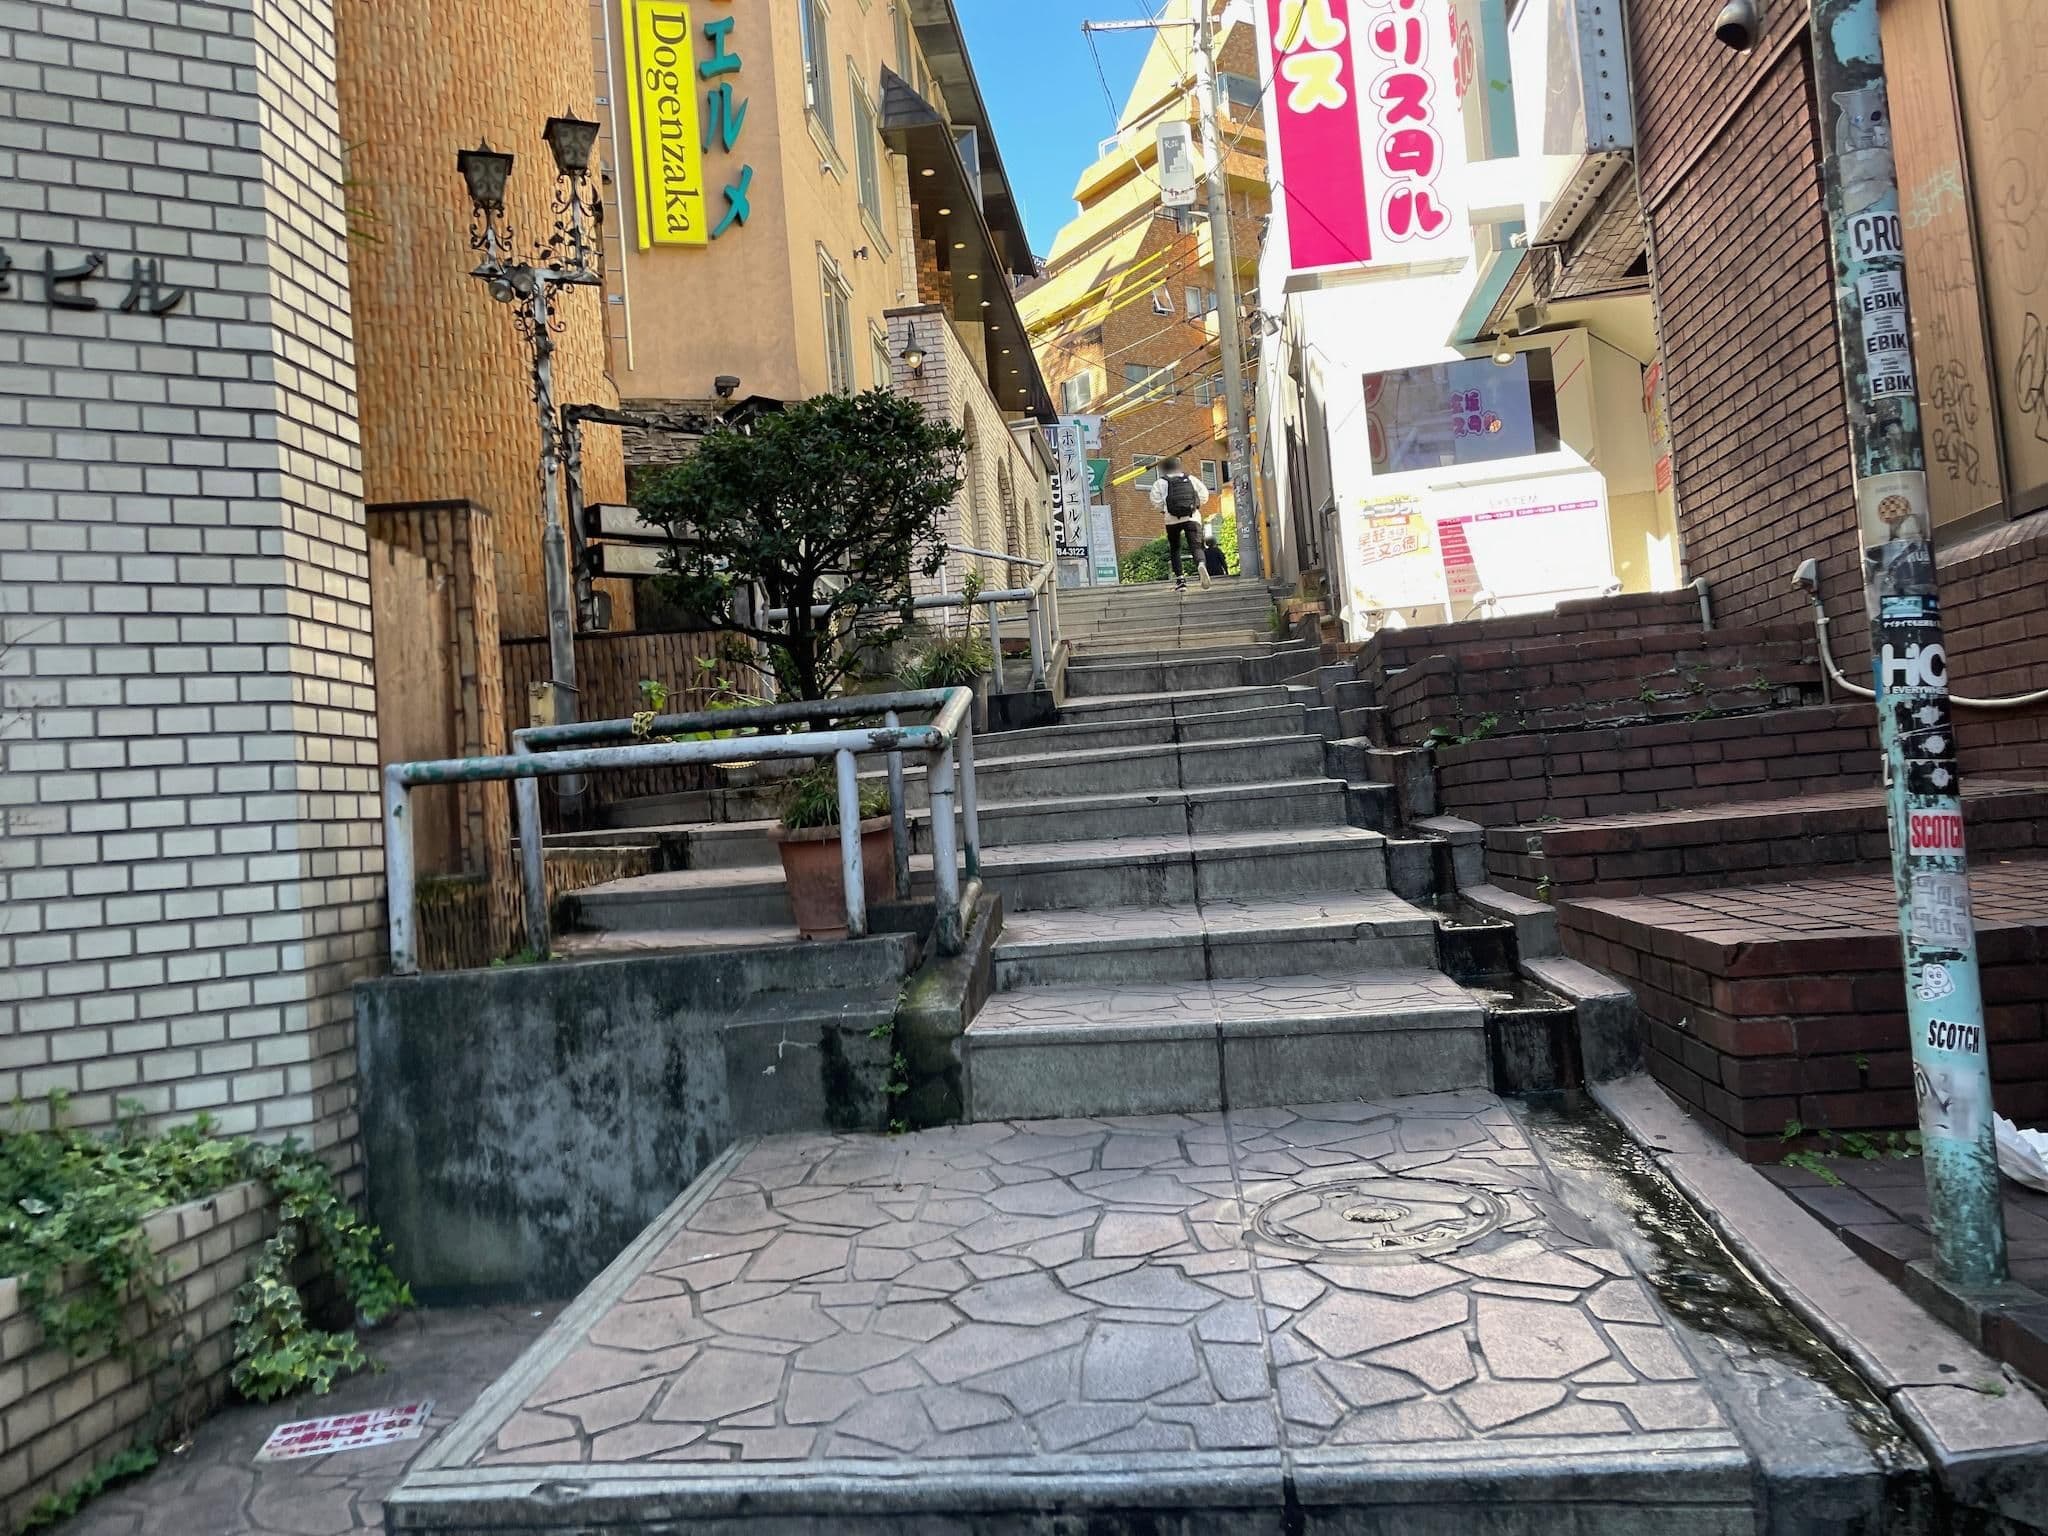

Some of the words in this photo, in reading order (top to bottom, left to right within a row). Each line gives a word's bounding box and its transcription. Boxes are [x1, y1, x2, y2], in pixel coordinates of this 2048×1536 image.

[645, 8, 700, 234] Dogenzaka
[699, 15, 754, 241] エルメ
[1369, 0, 1450, 241] リスタル
[1863, 291, 1904, 313] EBIK
[1866, 333, 1908, 353] EBIK
[1872, 374, 1913, 394] EBIK
[1062, 431, 1078, 481] ホテル
[1066, 493, 1081, 545] エルメ
[1927, 1018, 1981, 1054] SCOTCH
